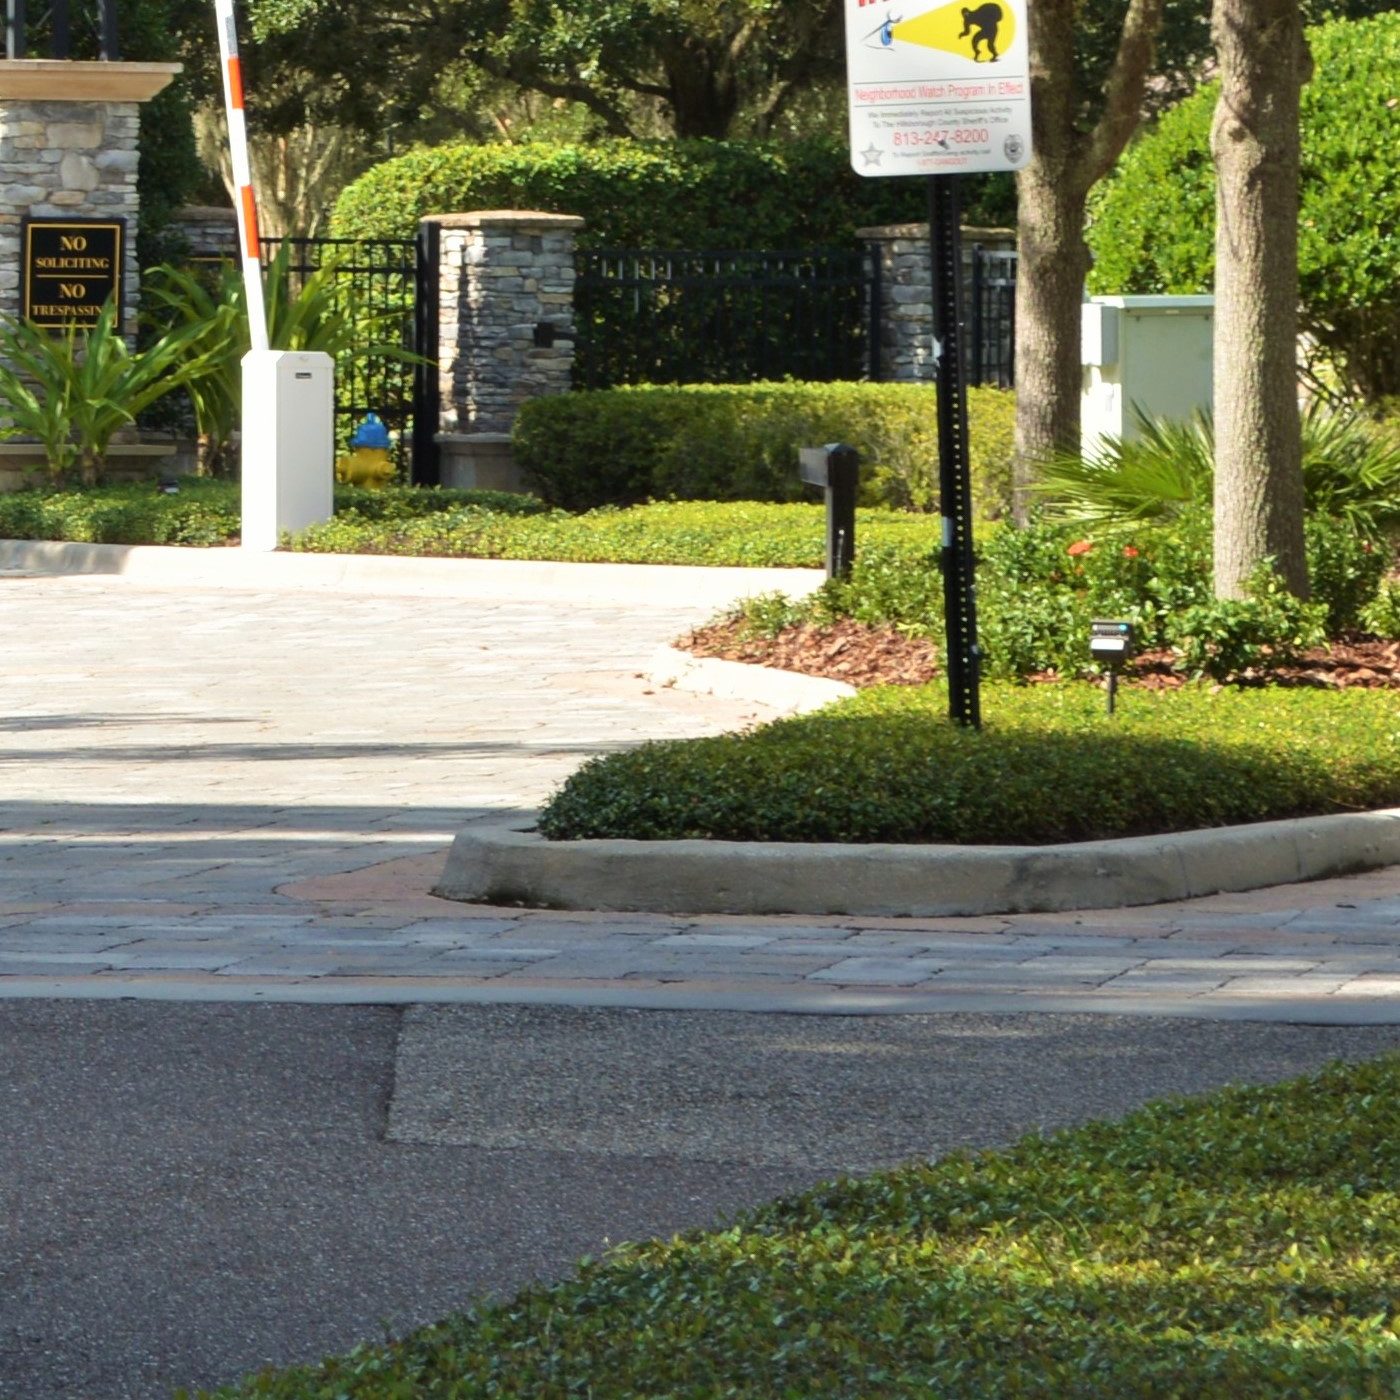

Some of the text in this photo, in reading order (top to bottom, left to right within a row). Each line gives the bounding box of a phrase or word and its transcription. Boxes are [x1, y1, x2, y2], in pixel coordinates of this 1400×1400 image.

[856, 81, 1024, 103] Neighborhood Watch Program In Effect
[920, 109, 942, 118] Report
[954, 108, 988, 116] Suspicious
[882, 120, 894, 128] The
[894, 128, 989, 146] 813-247-8200
[60, 236, 87, 251] NO
[35, 257, 109, 268] SOLICITING
[59, 283, 86, 298] NO
[32, 305, 102, 316] TRESPASSIN
